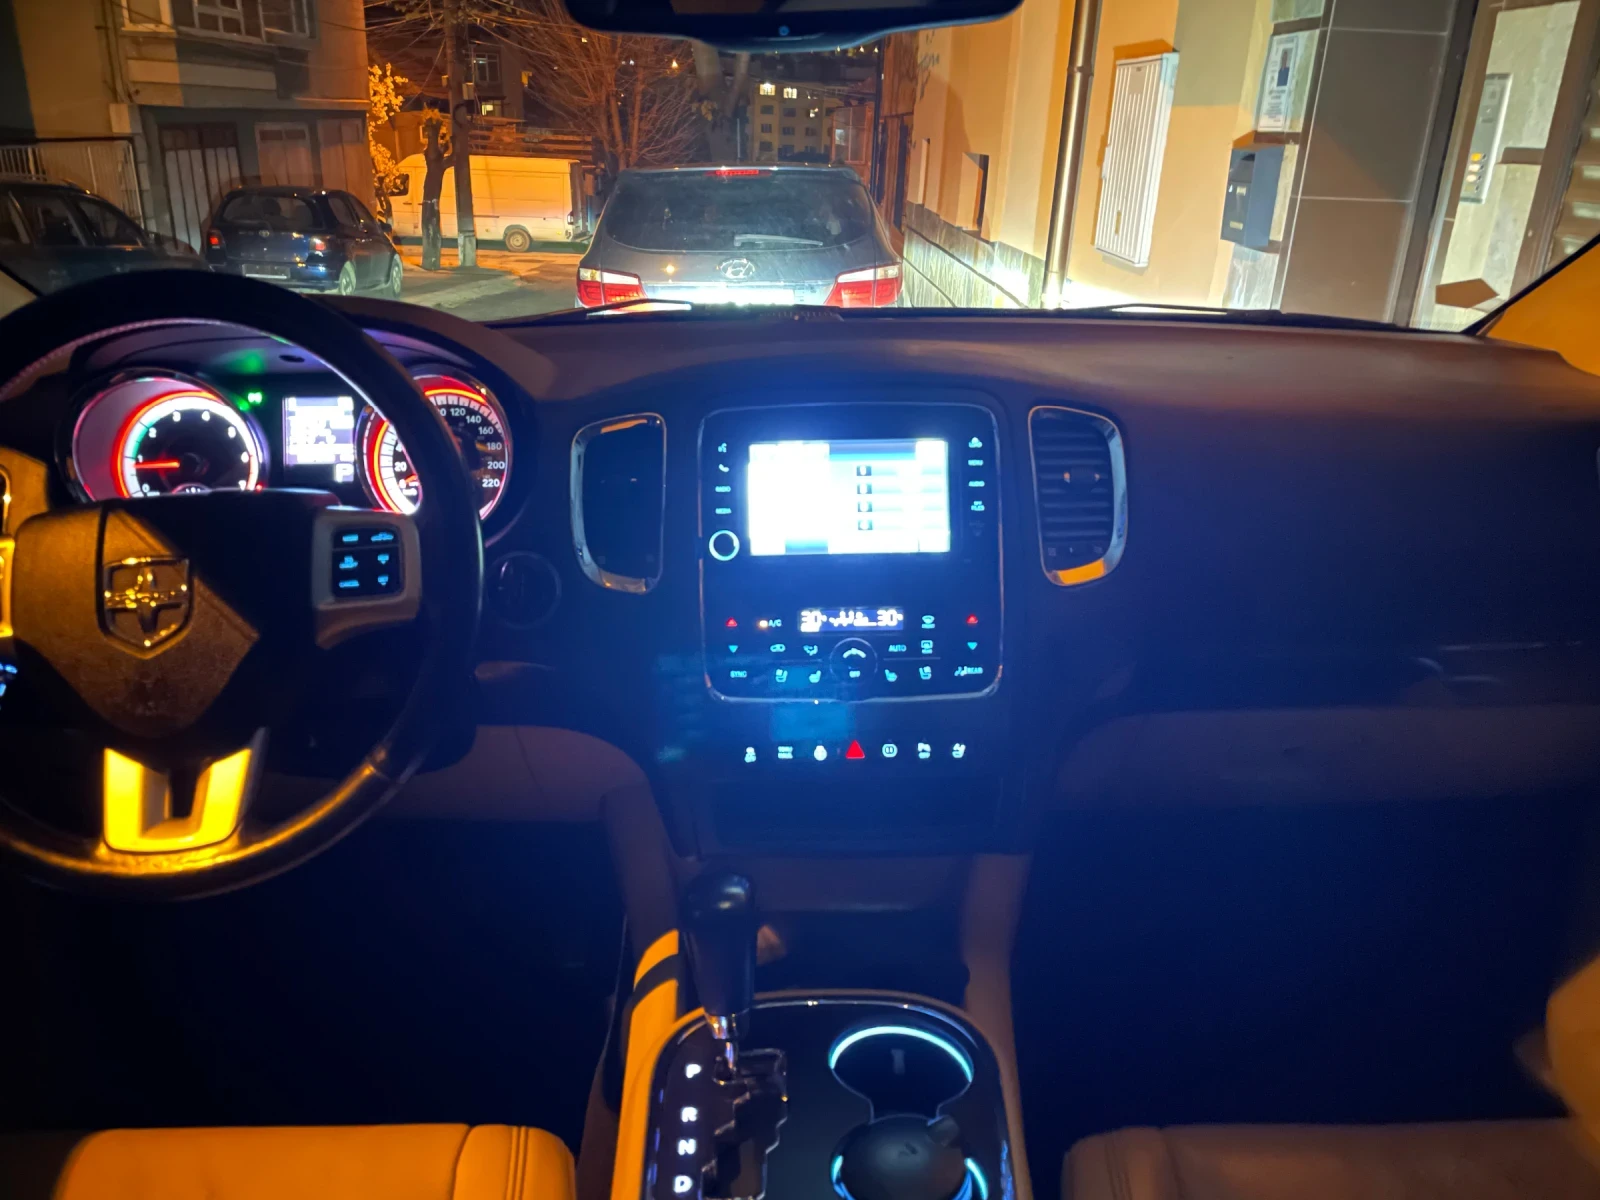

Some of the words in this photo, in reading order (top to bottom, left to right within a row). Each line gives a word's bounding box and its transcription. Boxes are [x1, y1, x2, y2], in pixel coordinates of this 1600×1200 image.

[173, 411, 181, 422] 3
[450, 407, 466, 416] 120
[466, 415, 482, 424] 140
[148, 427, 157, 438] 2
[478, 426, 494, 435] 160
[486, 442, 502, 451] 180
[394, 461, 407, 472] 20
[487, 461, 505, 470] 200
[335, 463, 354, 483] P
[142, 483, 150, 493] 0
[482, 478, 500, 488] 220
[768, 619, 782, 627] A/C
[888, 644, 907, 652] AUTO
[686, 1063, 701, 1078] P
[682, 1106, 697, 1122] R
[678, 1139, 696, 1155] N
[674, 1175, 693, 1193] D
